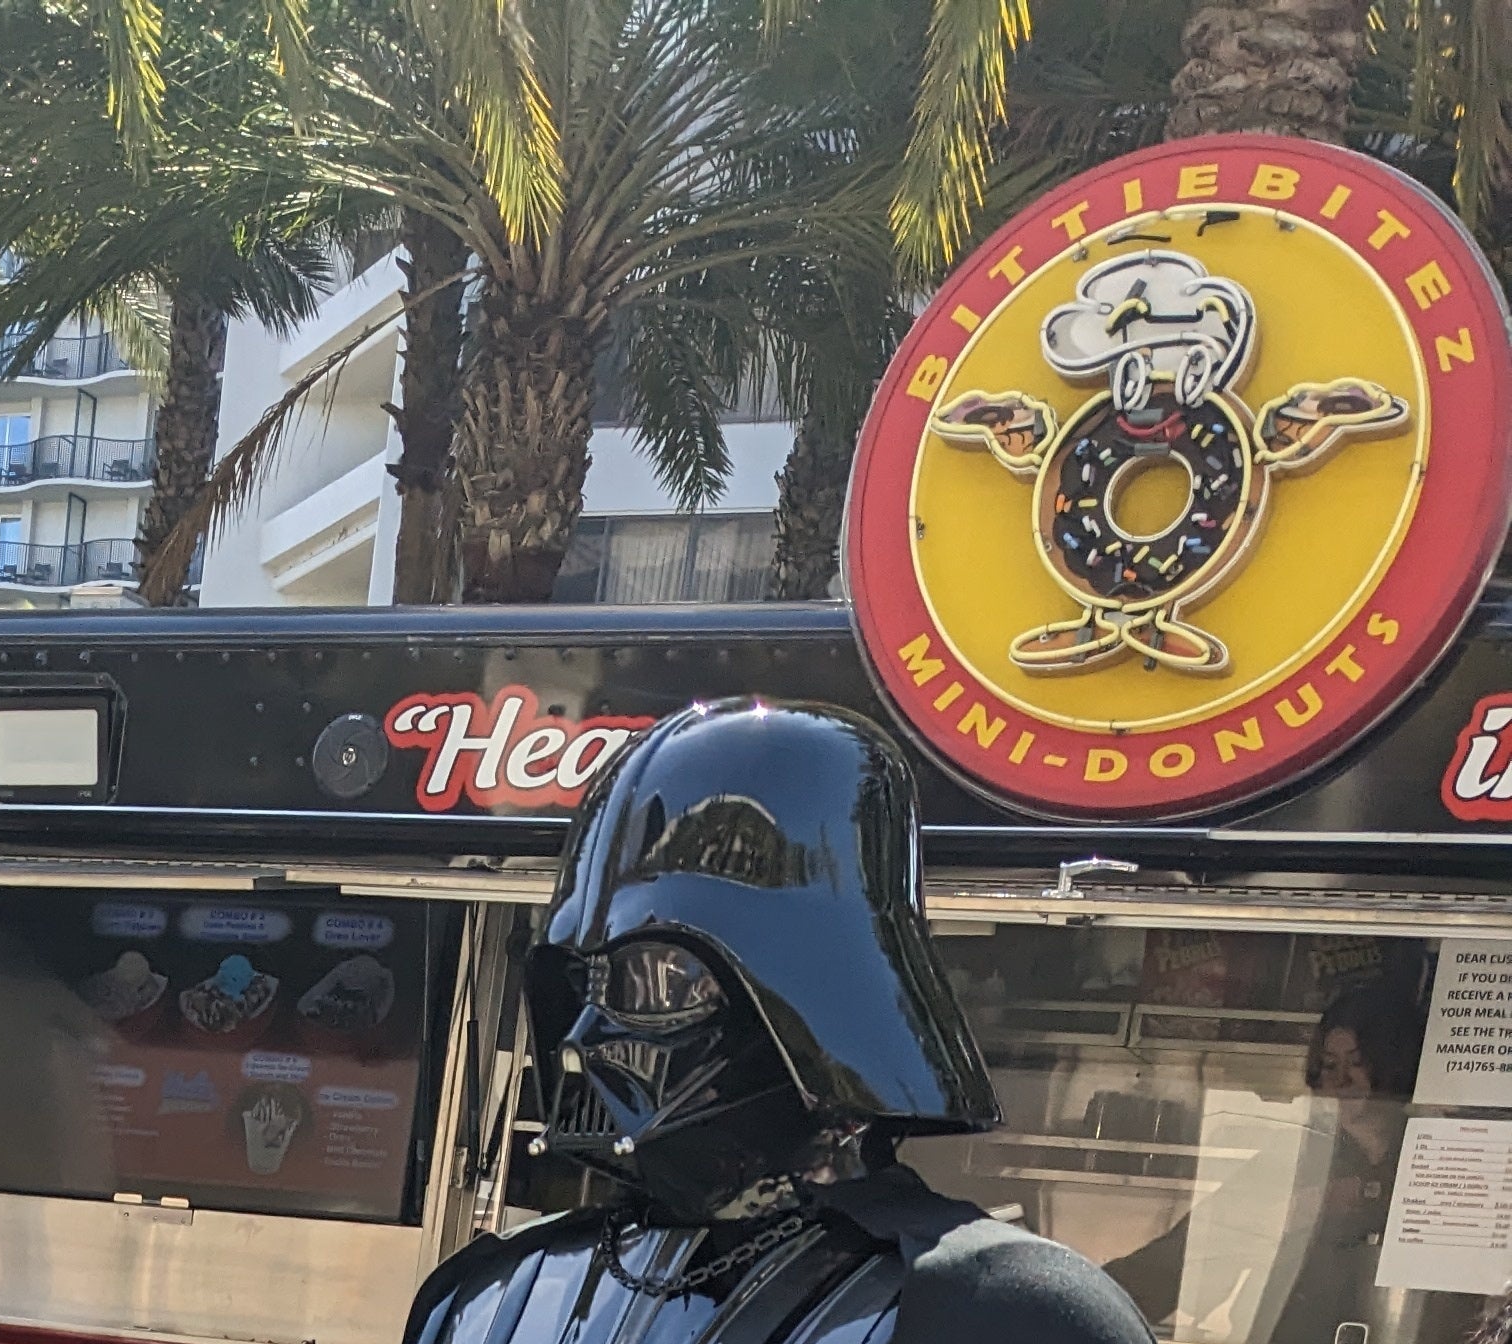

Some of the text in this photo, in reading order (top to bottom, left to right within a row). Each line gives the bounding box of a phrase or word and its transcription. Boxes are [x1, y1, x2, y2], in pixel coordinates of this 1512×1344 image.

[906, 162, 1476, 402] BITTIEBITEZ
[898, 612, 1400, 782] MINI-DONUTS
[1456, 953, 1487, 964] DEAR
[1458, 972, 1468, 983] IF
[1471, 972, 1496, 983] YOU
[1447, 990, 1493, 1001] RECEIVE
[1496, 991, 1504, 1001] A
[1440, 1007, 1506, 1019] YOUR MEAL
[1450, 1026, 1470, 1037] SEE
[1473, 1026, 1495, 1037] THE
[1436, 1043, 1494, 1055] MANAGER
